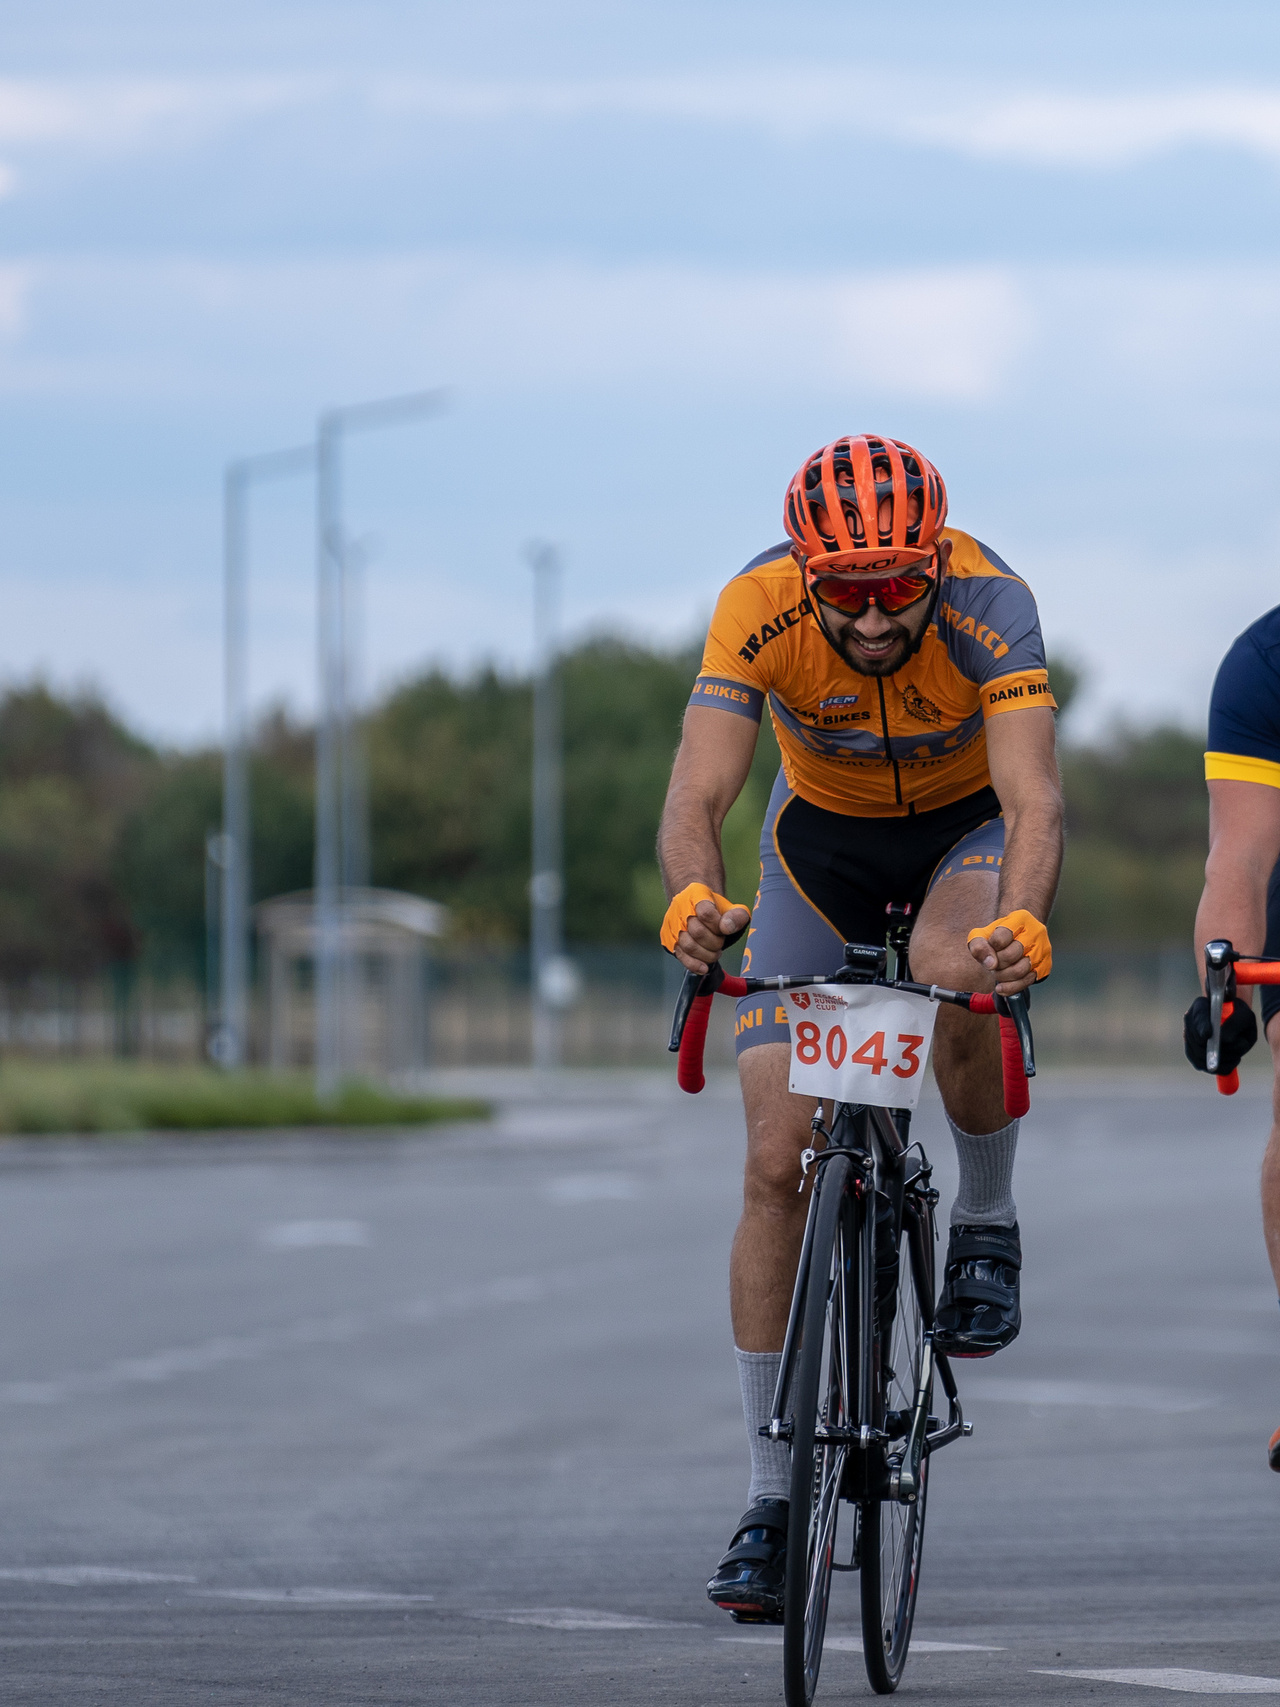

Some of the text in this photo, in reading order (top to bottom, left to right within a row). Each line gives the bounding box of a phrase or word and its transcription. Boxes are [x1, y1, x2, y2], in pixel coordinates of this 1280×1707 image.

[704, 684, 750, 704] BIKES
[989, 686, 1024, 704] DANI
[823, 711, 871, 725] BIKES
[853, 948, 878, 957] GARMIN
[796, 1021, 924, 1078] 8043
